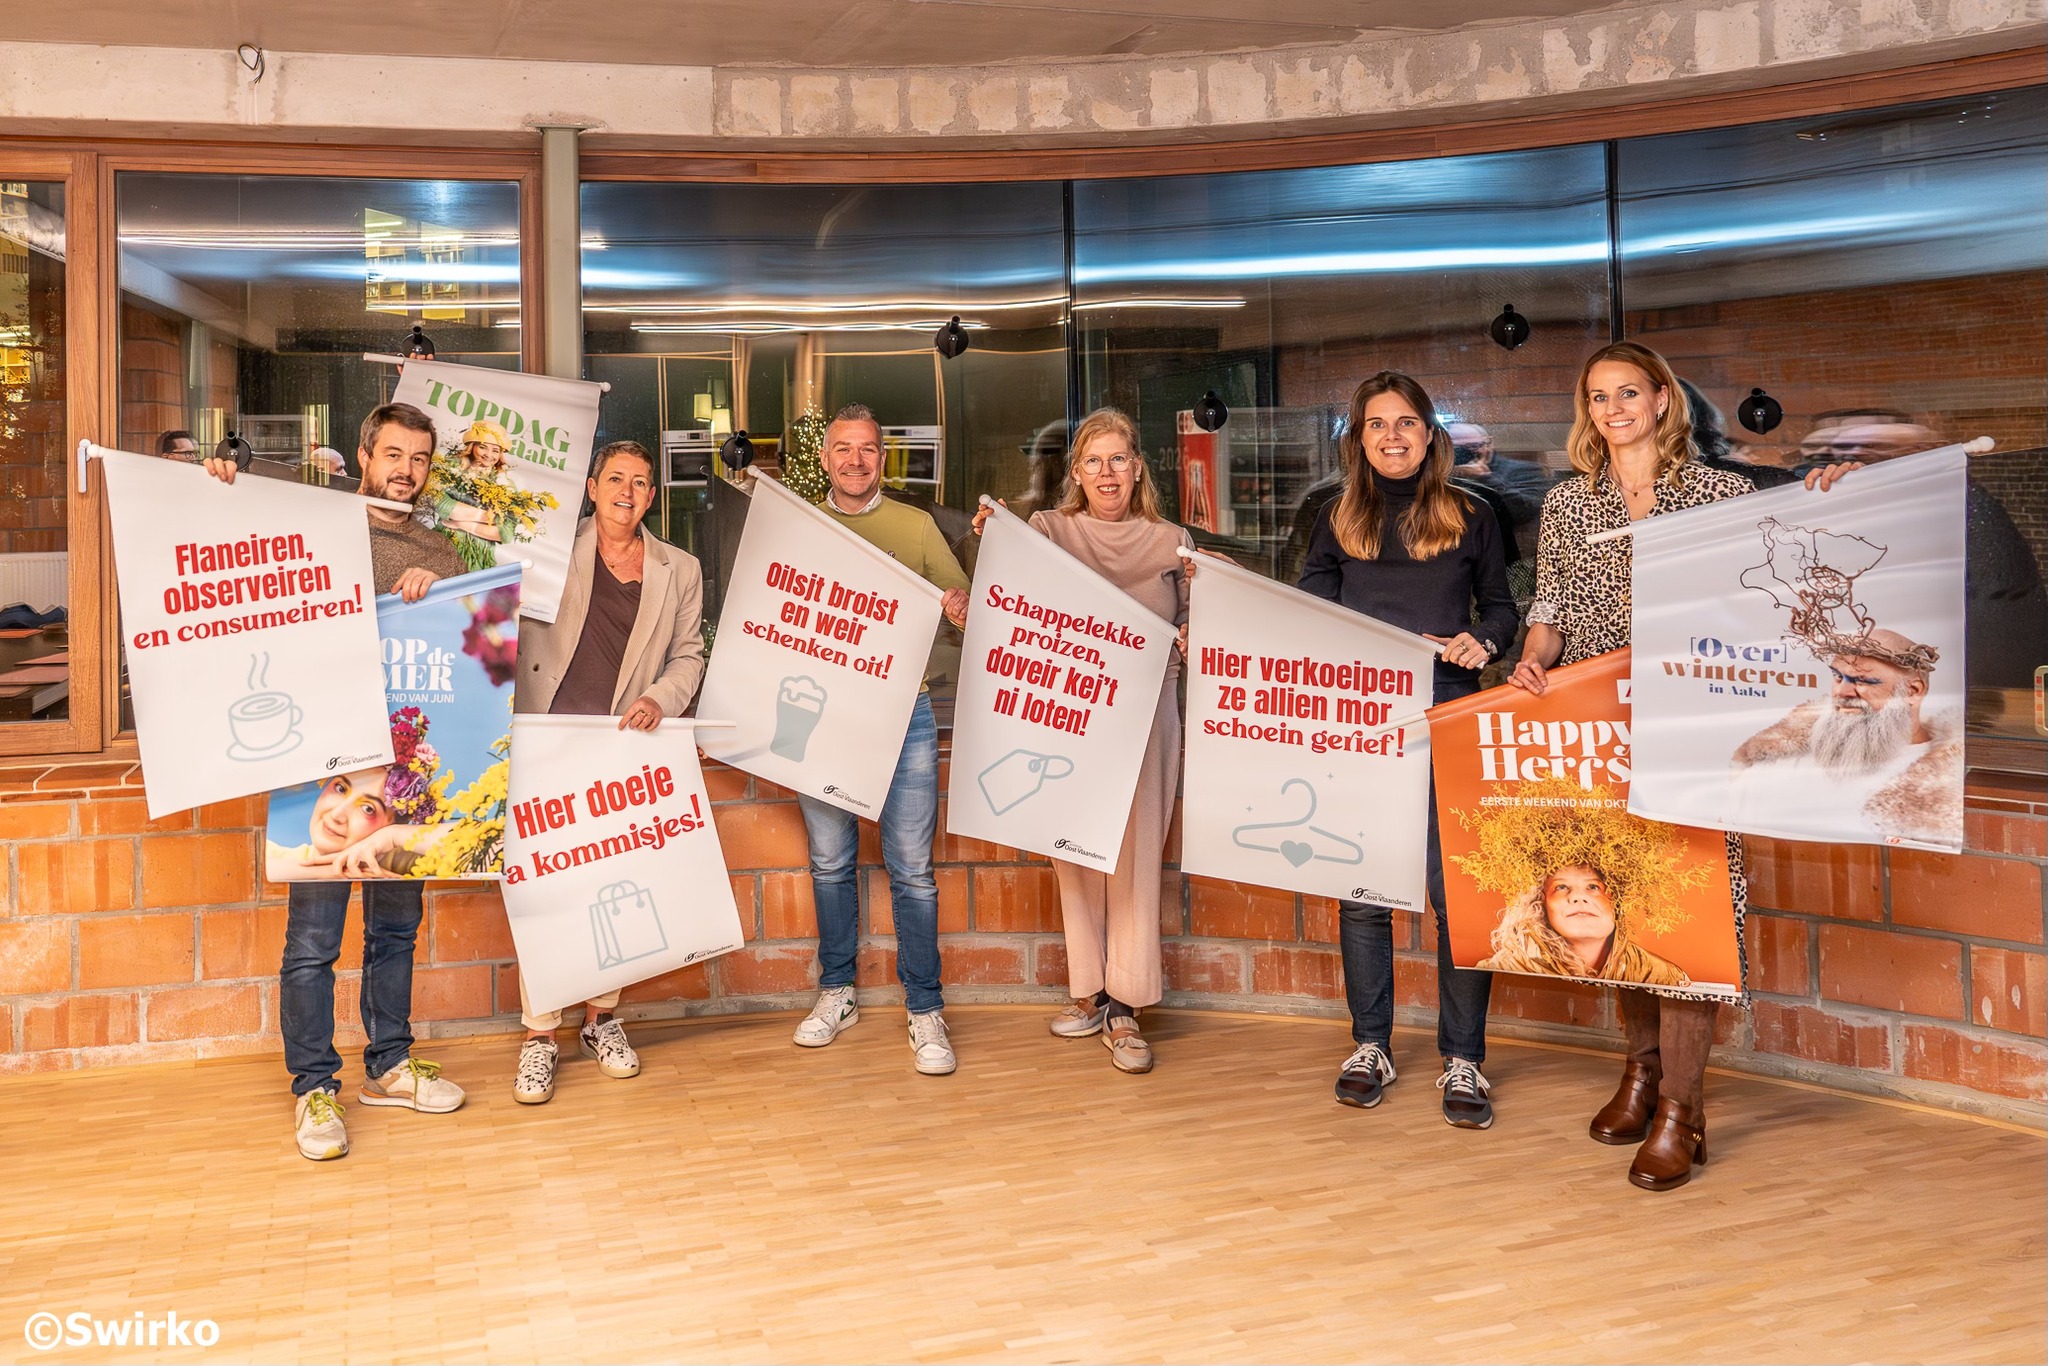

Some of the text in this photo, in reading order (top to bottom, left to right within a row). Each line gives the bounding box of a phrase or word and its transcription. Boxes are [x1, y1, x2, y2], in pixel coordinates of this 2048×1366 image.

[425, 378, 571, 453] TOPDAG
[509, 437, 567, 472] aalst
[175, 533, 313, 576] Flaneiren,
[163, 564, 331, 615] observeiren
[766, 561, 899, 625] Oilsjt broist
[133, 584, 363, 649] en consumeiren!
[780, 601, 868, 646] en weir
[986, 584, 1146, 650] Schappelekke
[427, 646, 456, 666] de
[742, 620, 894, 680] schenken oit!
[985, 645, 1061, 690] doveir
[1009, 626, 1106, 669] proizen,
[1690, 636, 1787, 664] [Over]
[1201, 646, 1413, 697] Hier verkoeipen
[1662, 657, 1818, 689] winteren
[1709, 683, 1767, 698] in Aalst
[408, 693, 429, 703] VAN
[430, 693, 455, 704] JUNI
[993, 687, 1091, 737] ni loten!
[1217, 685, 1392, 727] ze allien mor
[1203, 717, 1405, 758] schoein gerief!
[1474, 711, 1631, 757] Happy
[513, 764, 674, 839] Hier doeje
[1481, 796, 1521, 807] EERSTE
[1523, 797, 1577, 808] WEEKEND
[1578, 798, 1602, 808] VAN
[531, 793, 705, 878] kommisjes!
